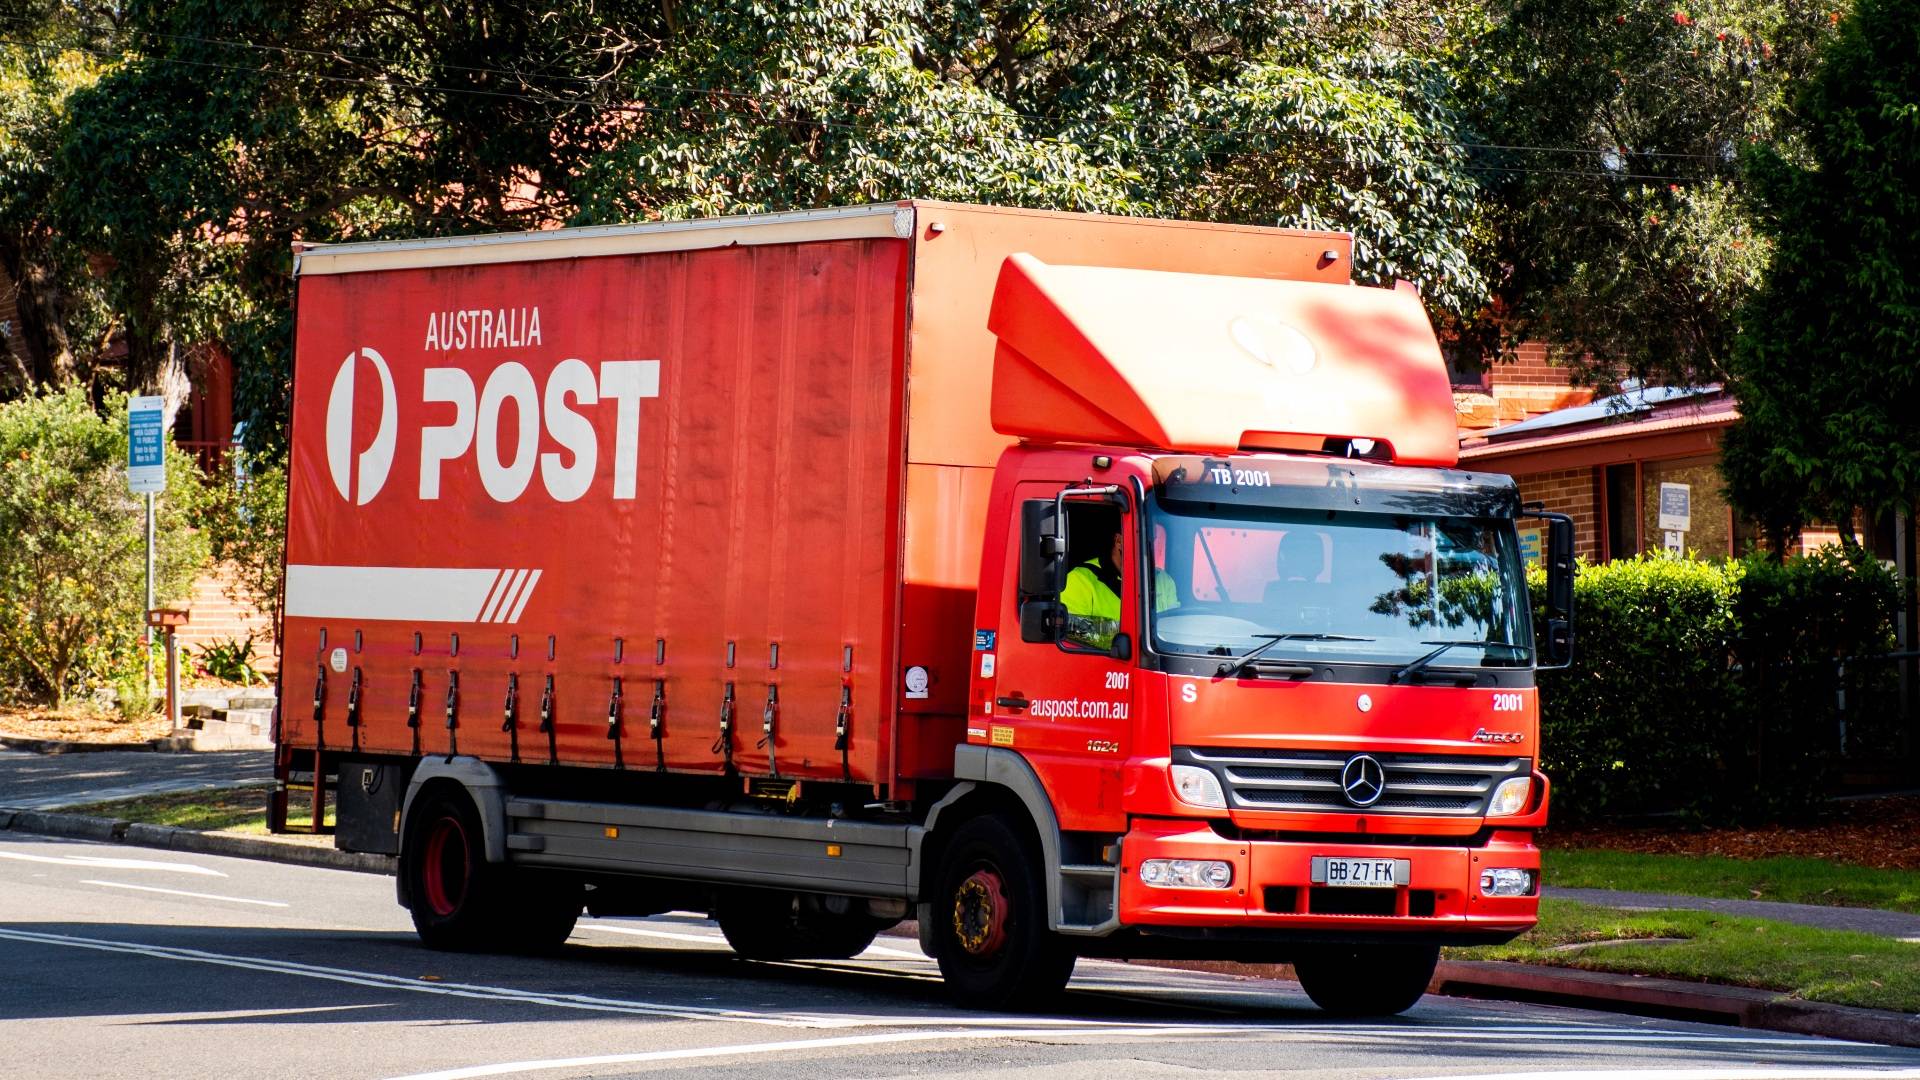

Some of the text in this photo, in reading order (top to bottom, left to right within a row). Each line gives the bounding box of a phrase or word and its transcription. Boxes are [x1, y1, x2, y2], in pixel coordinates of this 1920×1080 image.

[425, 306, 541, 351] AUSTRALIA
[419, 359, 660, 503] POST
[1211, 468, 1271, 487] TB 2001
[1105, 672, 1129, 690] 2001
[1182, 683, 1197, 703] S
[1031, 698, 1128, 722] auspost.com.au
[1493, 694, 1523, 712] 2001
[1087, 740, 1119, 753] 1624
[1330, 862, 1393, 881] BB 27 FK
